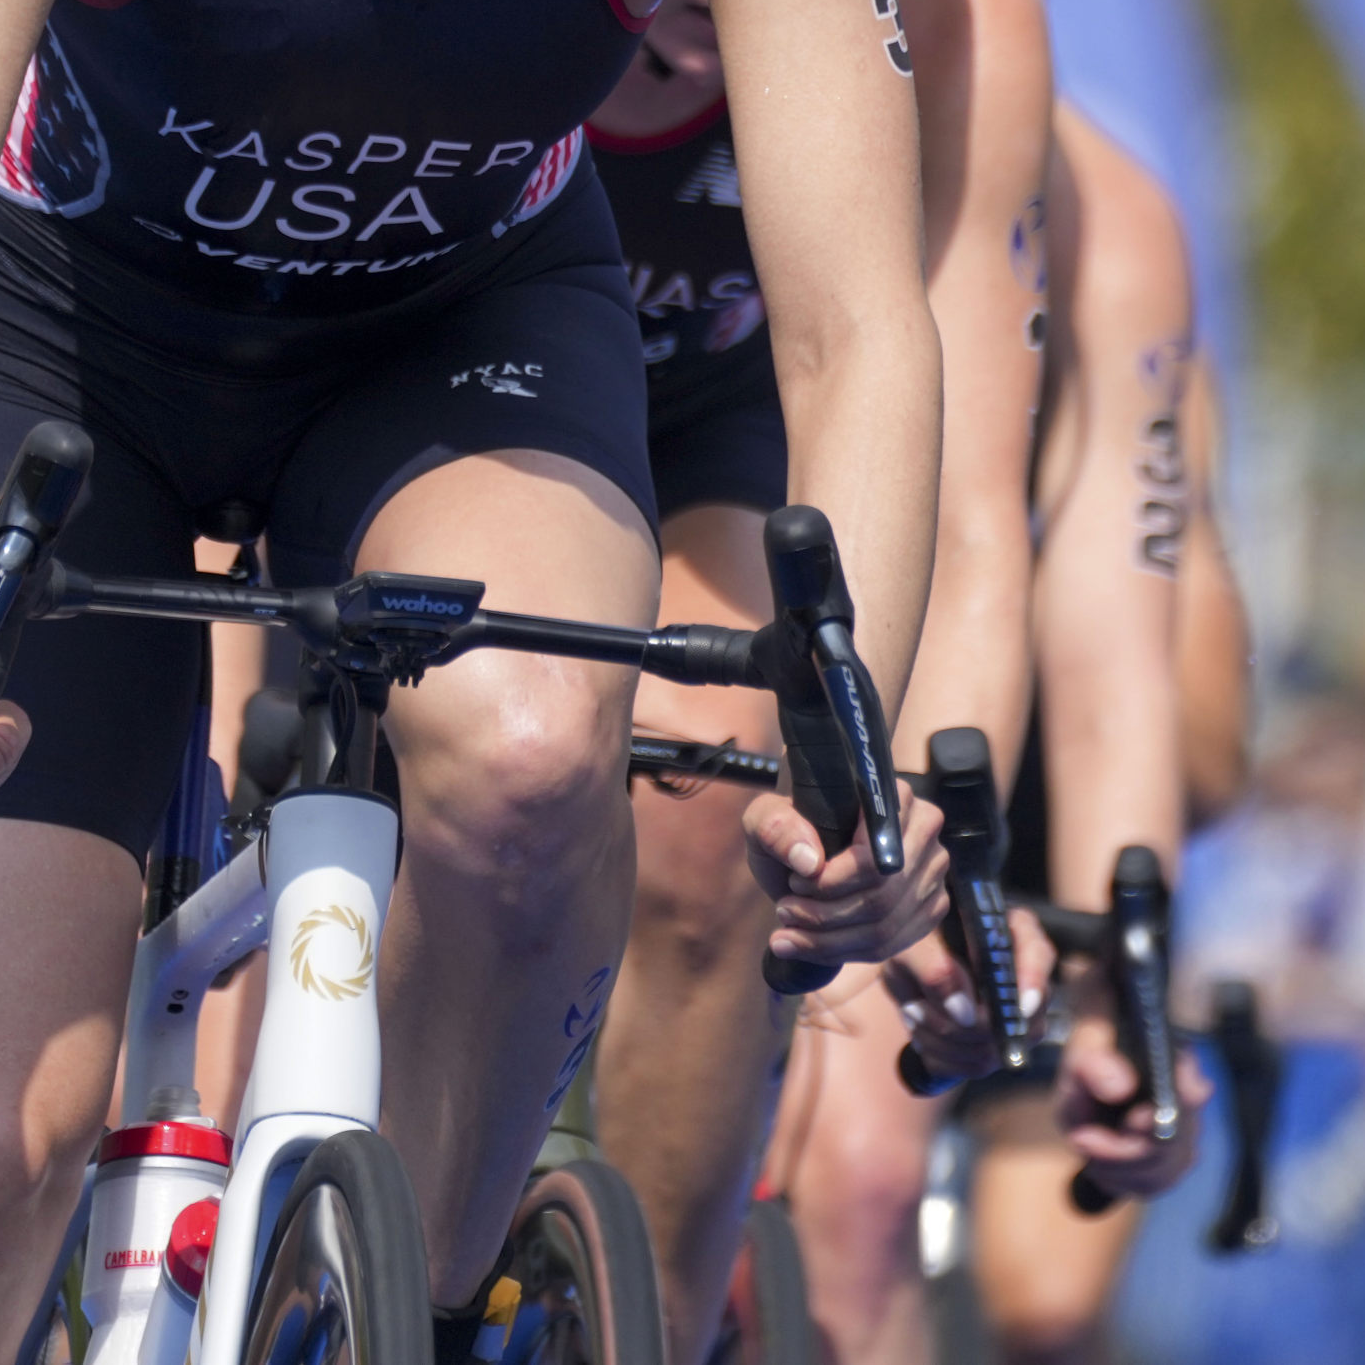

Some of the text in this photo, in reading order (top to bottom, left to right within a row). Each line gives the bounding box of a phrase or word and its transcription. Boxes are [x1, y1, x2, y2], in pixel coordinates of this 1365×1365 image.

[184, 166, 444, 242] USA
[382, 594, 464, 616] wahoo
[841, 666, 887, 817] DURA-ACE
